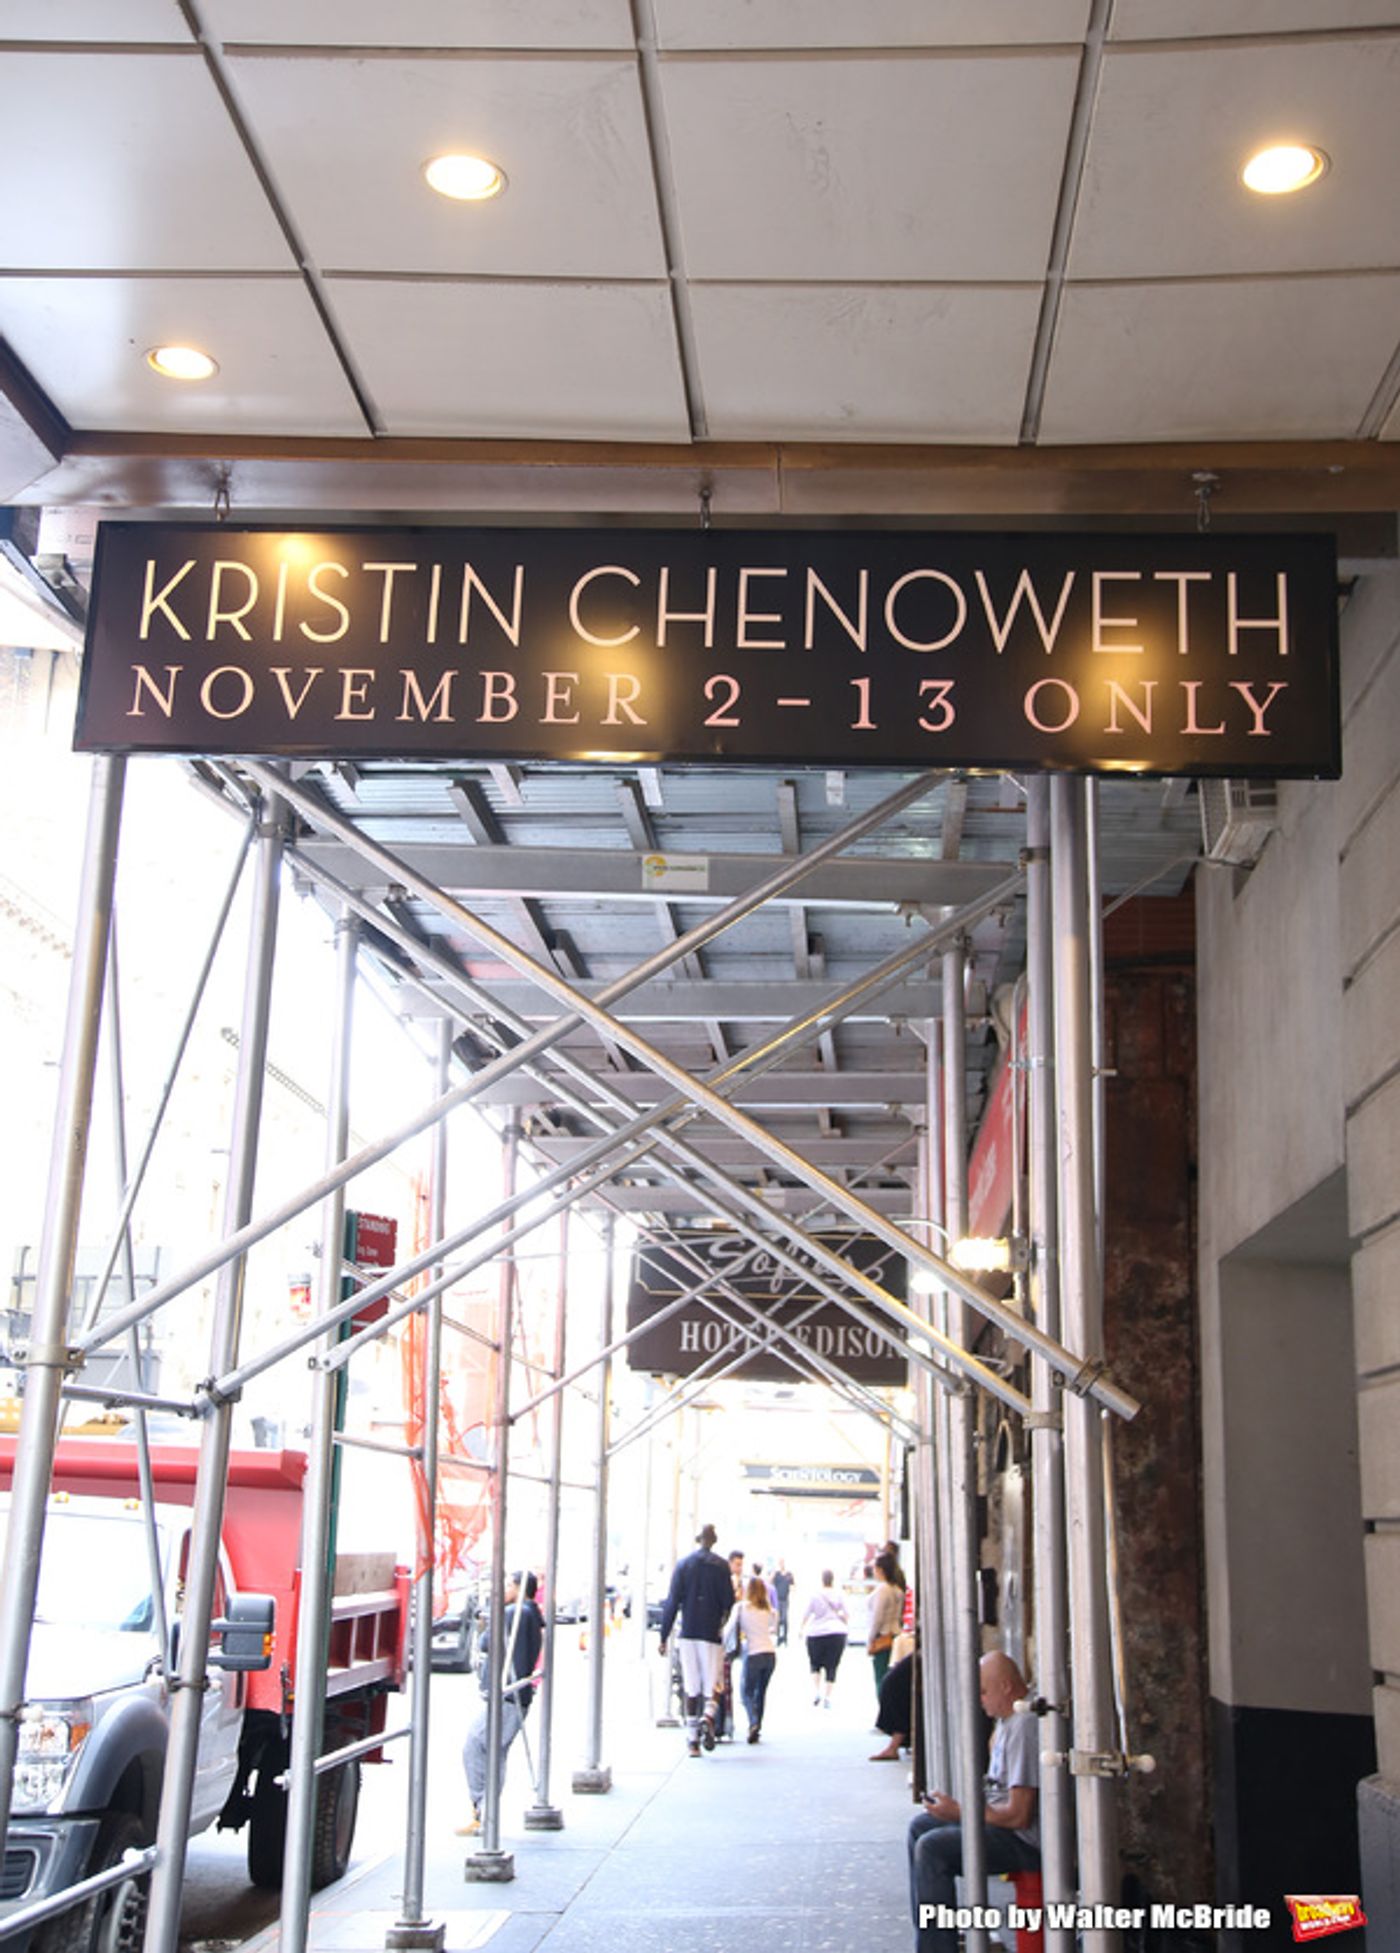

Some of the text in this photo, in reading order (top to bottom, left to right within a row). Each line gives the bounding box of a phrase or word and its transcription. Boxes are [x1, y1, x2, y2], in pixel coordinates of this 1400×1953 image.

[138, 558, 1290, 656] KRISTIN CHENOWETH
[126, 664, 647, 726] NOVEMBER
[1023, 677, 1289, 737] ONLY
